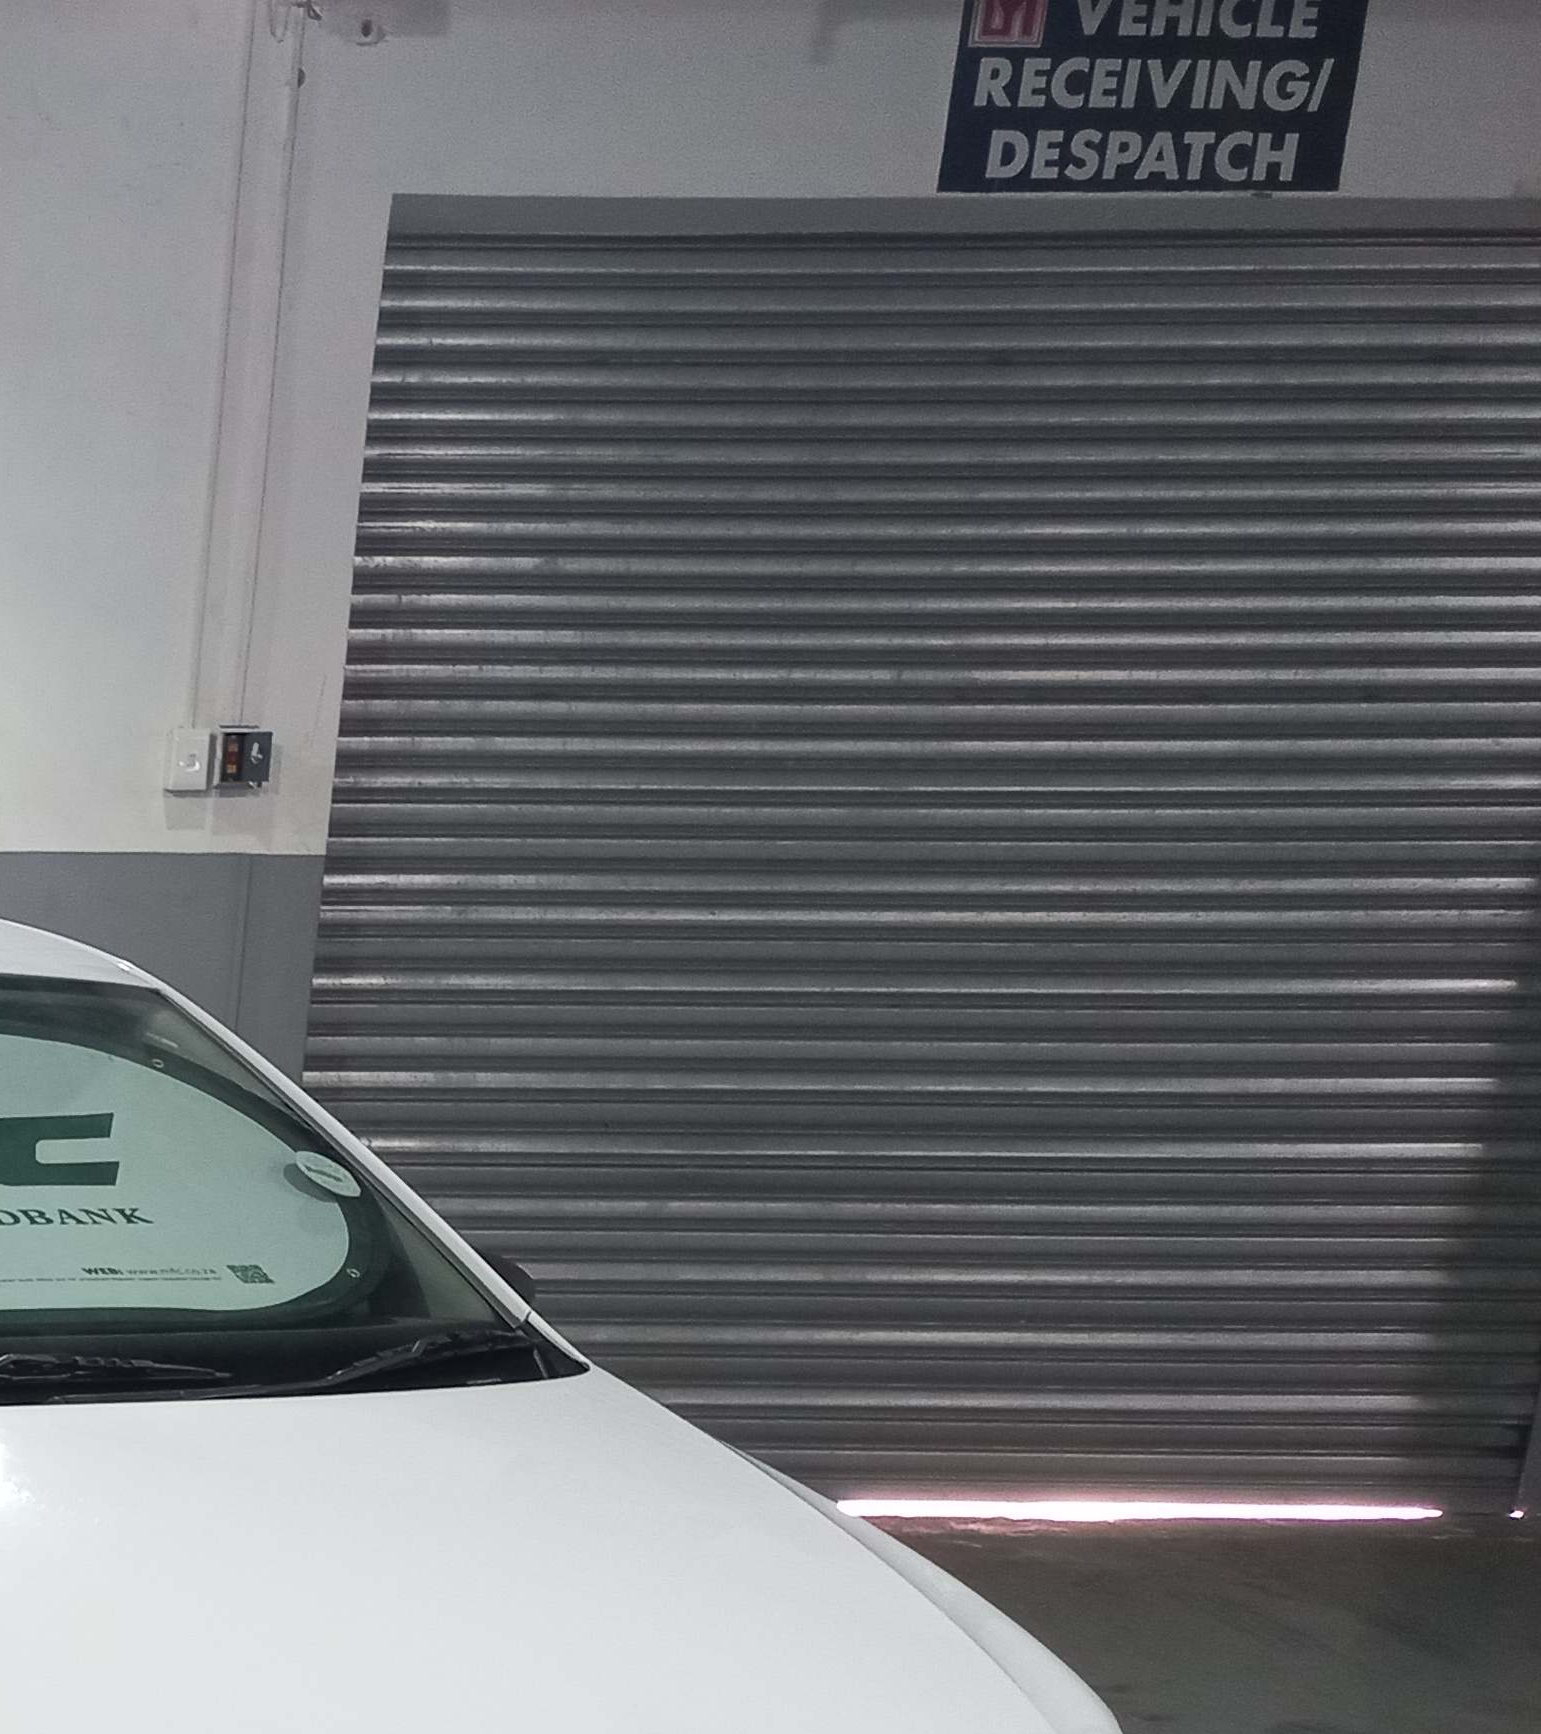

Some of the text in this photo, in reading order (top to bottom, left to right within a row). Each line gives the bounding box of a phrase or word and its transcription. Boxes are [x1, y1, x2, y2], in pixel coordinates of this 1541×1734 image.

[1077, 0, 1318, 39] VEHICLE
[974, 56, 1334, 113] RECEIVING/
[985, 129, 1300, 182] DESPATCH
